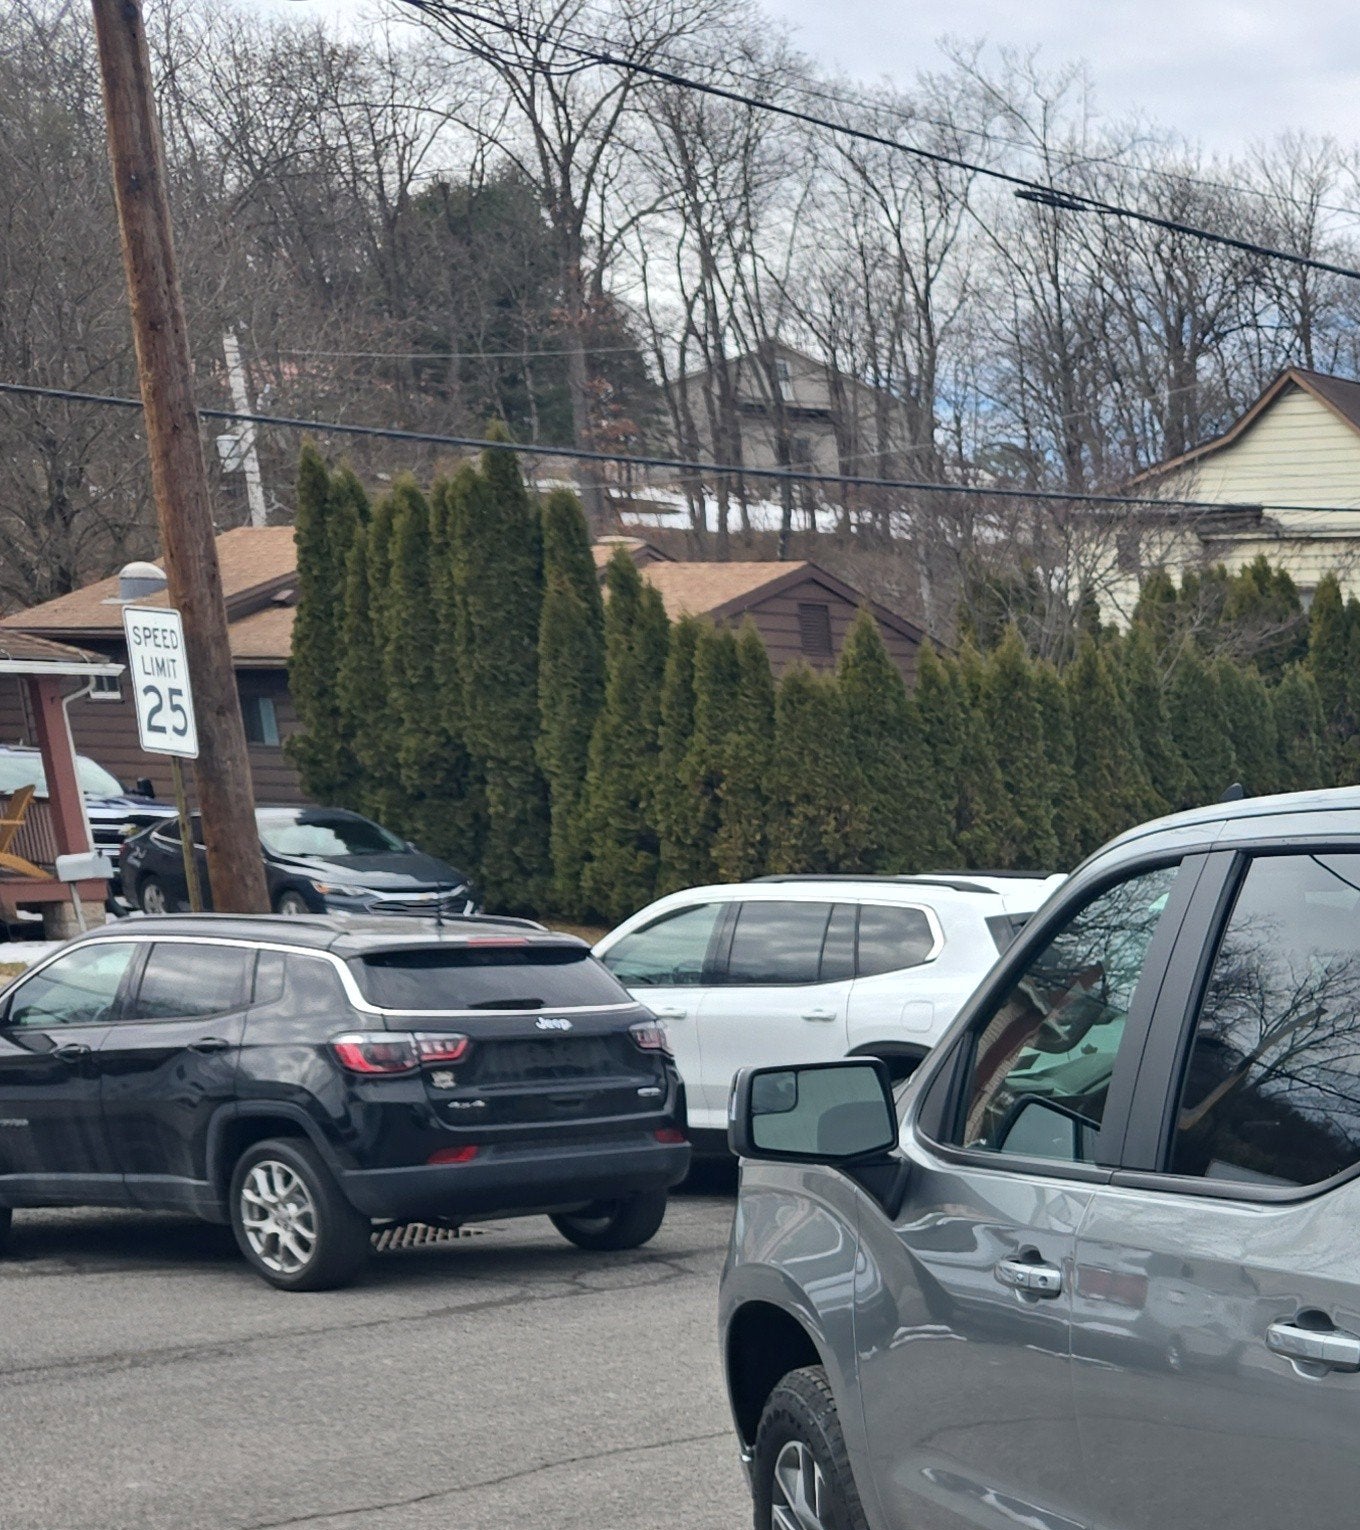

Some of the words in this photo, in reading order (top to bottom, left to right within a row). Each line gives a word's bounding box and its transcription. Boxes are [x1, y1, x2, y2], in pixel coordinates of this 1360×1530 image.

[132, 626, 179, 650] SPEED
[141, 655, 177, 679] LIMIT
[142, 685, 188, 737] 25
[535, 1016, 573, 1031] Jeep
